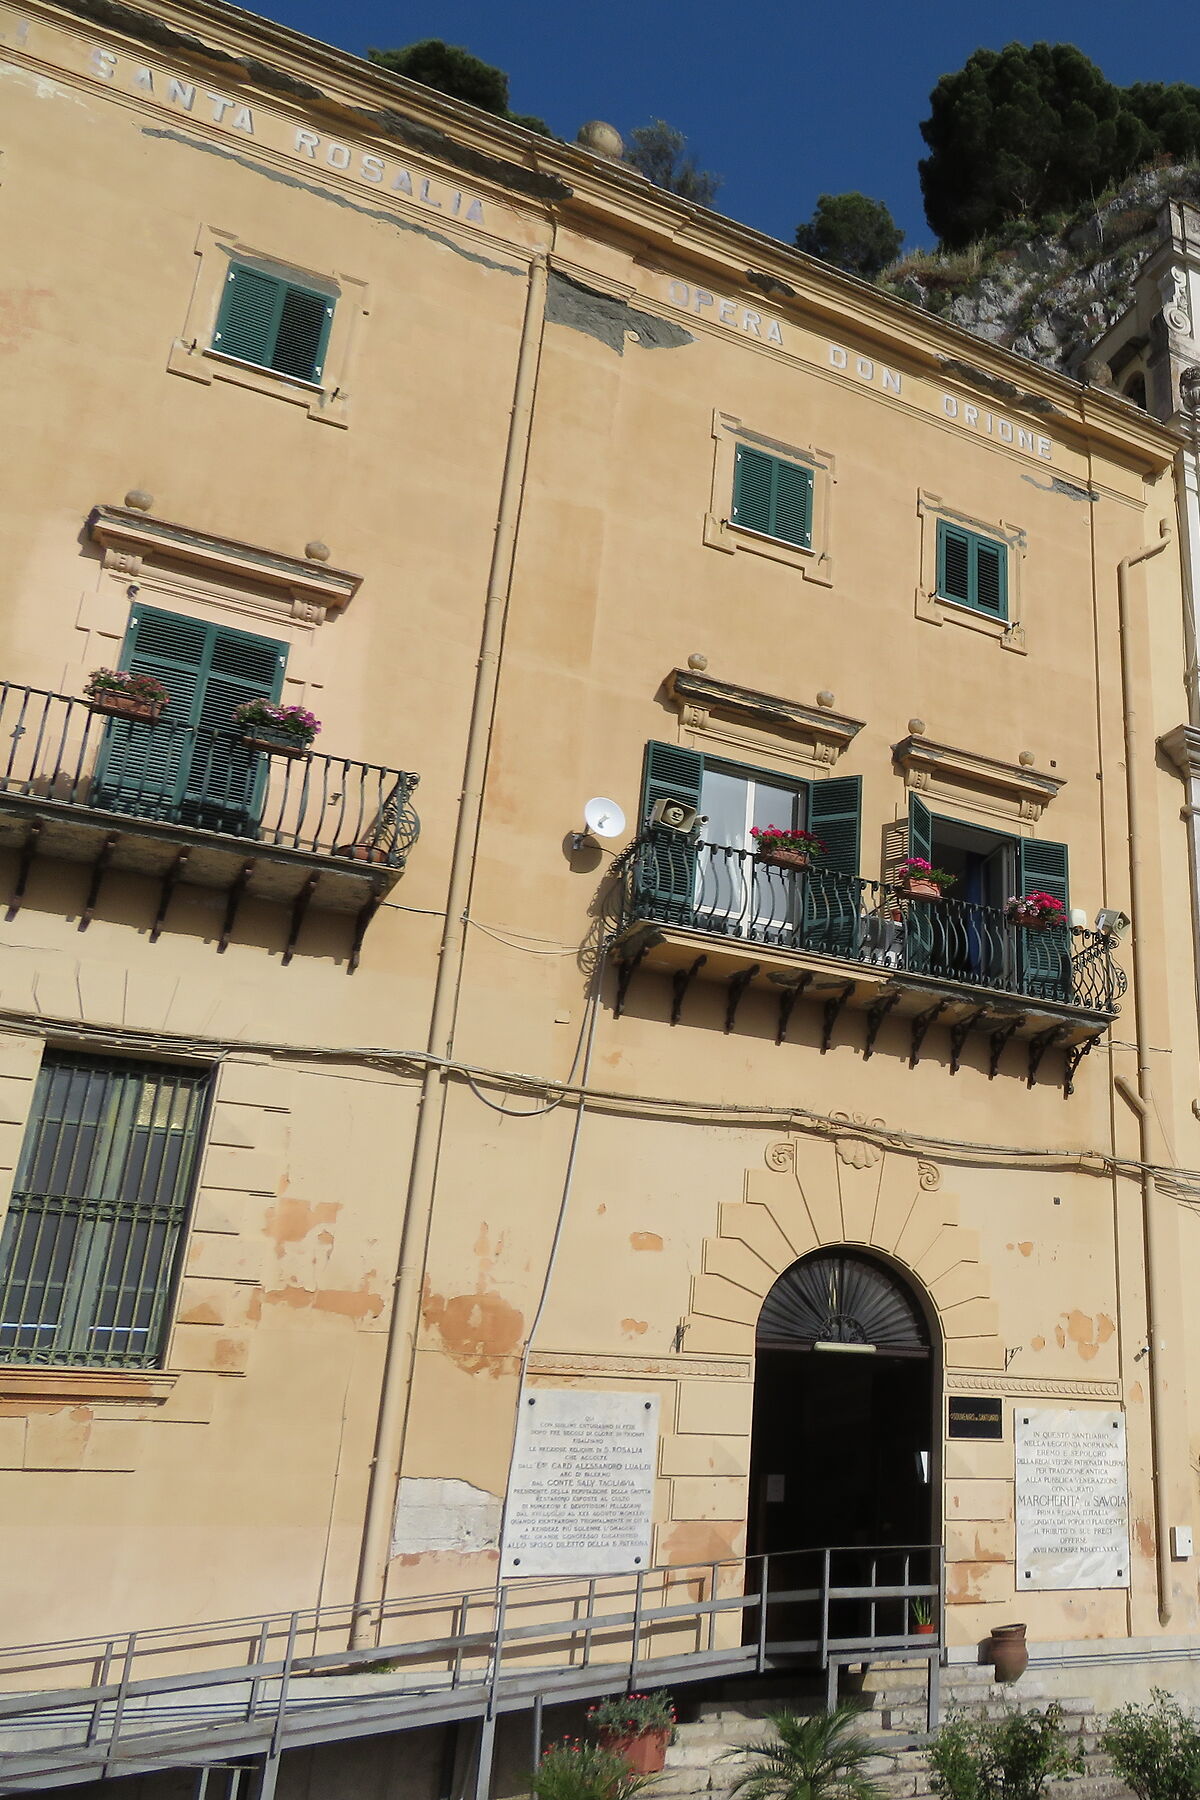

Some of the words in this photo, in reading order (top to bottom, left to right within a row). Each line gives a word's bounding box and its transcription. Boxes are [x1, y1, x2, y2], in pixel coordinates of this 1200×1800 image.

[89, 48, 254, 135] SANTA
[294, 128, 485, 225] ROSALIA
[668, 280, 783, 345] OPERA
[829, 343, 902, 394] DON
[943, 394, 1052, 460] ORIONE
[1018, 1495, 1080, 1507] MARGHERITA
[1093, 1495, 1126, 1507] SAVOIA
[1071, 1450, 1107, 1458] SEPOLCRO
